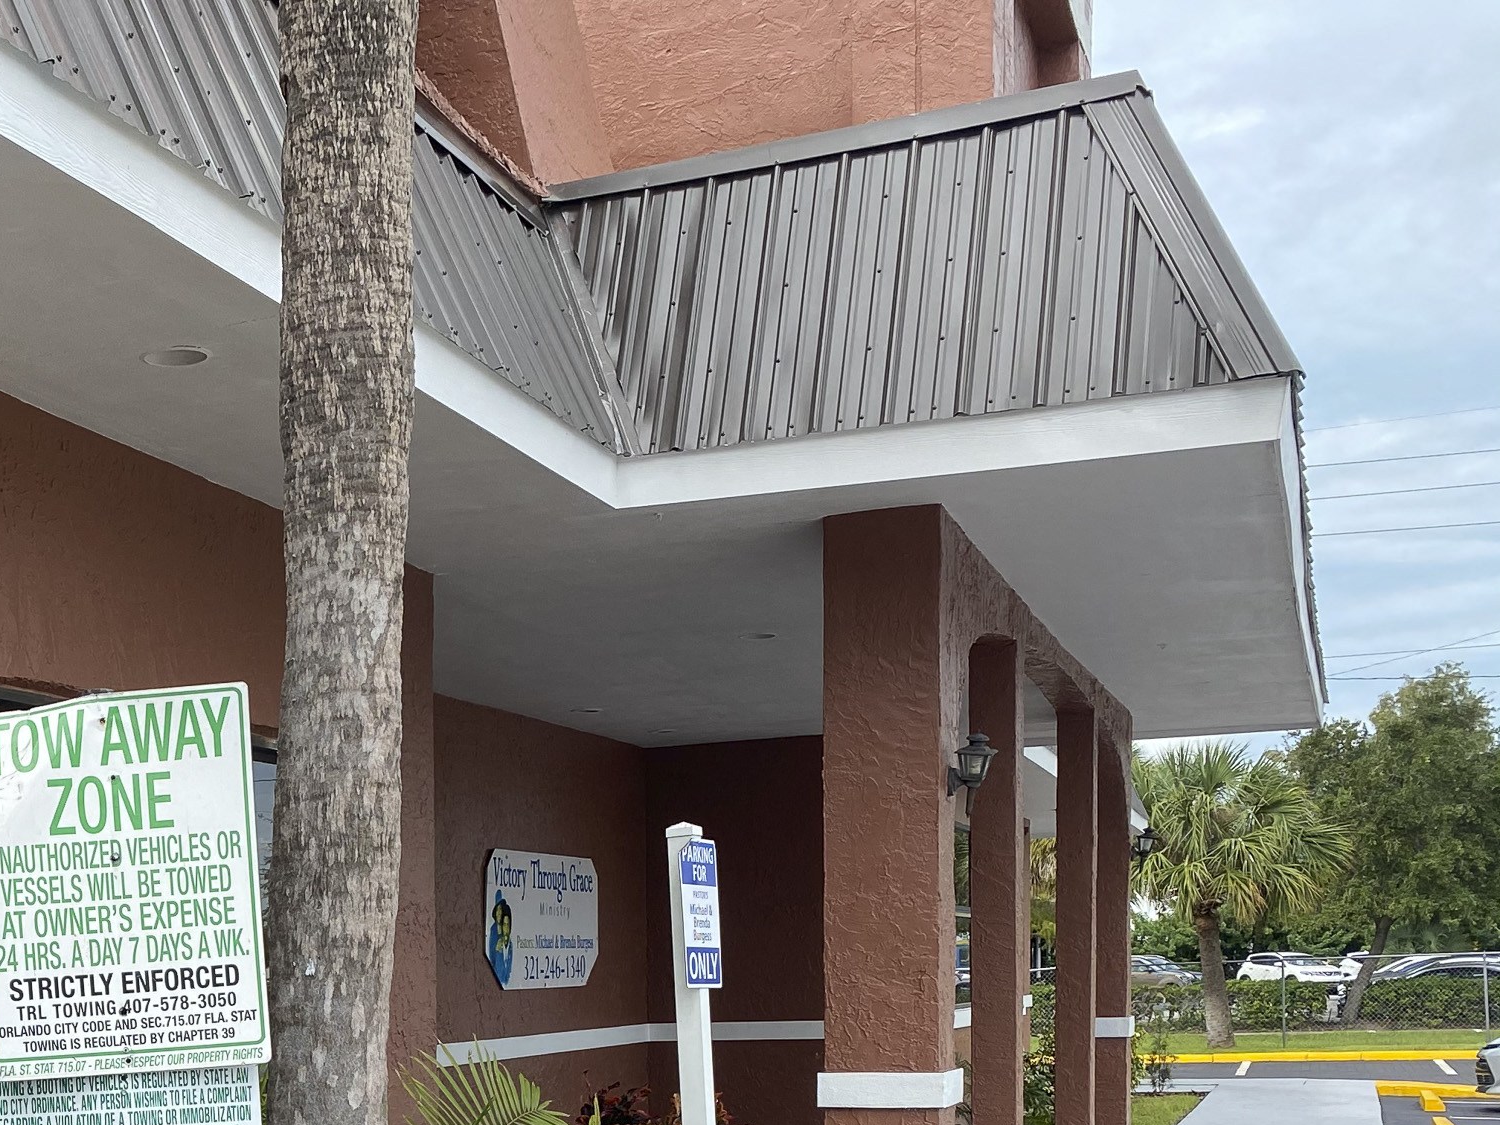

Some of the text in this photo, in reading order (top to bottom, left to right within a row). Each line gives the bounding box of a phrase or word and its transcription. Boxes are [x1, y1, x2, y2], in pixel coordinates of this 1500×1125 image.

[100, 696, 231, 766] AWAY
[47, 771, 174, 835] ZONE
[126, 832, 211, 866] VEHICLES
[217, 830, 242, 859] OR
[681, 845, 714, 865] PARKING
[0, 864, 232, 906] VESSELS WILL BE TOWED
[493, 857, 593, 903] Victory Through Grace
[692, 864, 707, 882] FOR
[2, 896, 236, 939] AT OWNER'S EXPENSE
[540, 902, 570, 919] Ministry
[24, 941, 66, 971] HRS.
[71, 940, 84, 968] A
[89, 937, 123, 967] DAY
[129, 937, 139, 964] 7
[146, 931, 193, 963] DAYS
[198, 931, 211, 959] A
[214, 928, 249, 957] WK.
[524, 955, 586, 980] 321-246-1340
[689, 951, 718, 980] ONLY
[9, 964, 240, 1001] STRICTLY ENFORCED
[16, 991, 237, 1021] TRL TOWING 407-578-3050
[0, 1009, 257, 1038] ORLANDO CITY CODE AND SEC.715.07 FLA. STAT
[23, 1027, 235, 1053] TOWING IS REGULATED BY CHAPTER 39
[0, 1065, 16, 1077] FLA.
[20, 1064, 32, 1075] ST.
[34, 1062, 55, 1074] STAT.
[58, 1060, 86, 1073] 715.07
[94, 1057, 126, 1070] PLEASE
[167, 1053, 185, 1065] OUR
[187, 1050, 231, 1064] PROPERTY
[232, 1047, 263, 1060] RIGHTS
[27, 1080, 34, 1095] &
[36, 1078, 73, 1095] BOOTING
[76, 1077, 86, 1092] OF
[88, 1074, 129, 1092] VEHICLES
[131, 1073, 139, 1089] IS
[141, 1070, 188, 1089] REGULATED
[191, 1069, 200, 1086] BY
[204, 1068, 228, 1085] STATE
[231, 1067, 249, 1083] LAW
[10, 1098, 29, 1115] CITY
[31, 1095, 79, 1114] ORDINANCE.
[81, 1095, 97, 1111] ANY
[100, 1091, 132, 1110] PERSON
[133, 1090, 167, 1108] WISHING
[170, 1090, 180, 1107] TO
[182, 1089, 197, 1105] FILE
[200, 1088, 205, 1104] A
[207, 1086, 252, 1104] COMPLAINT
[165, 1109, 177, 1125] OR
[180, 1105, 251, 1124] IMMOBILIZATION
